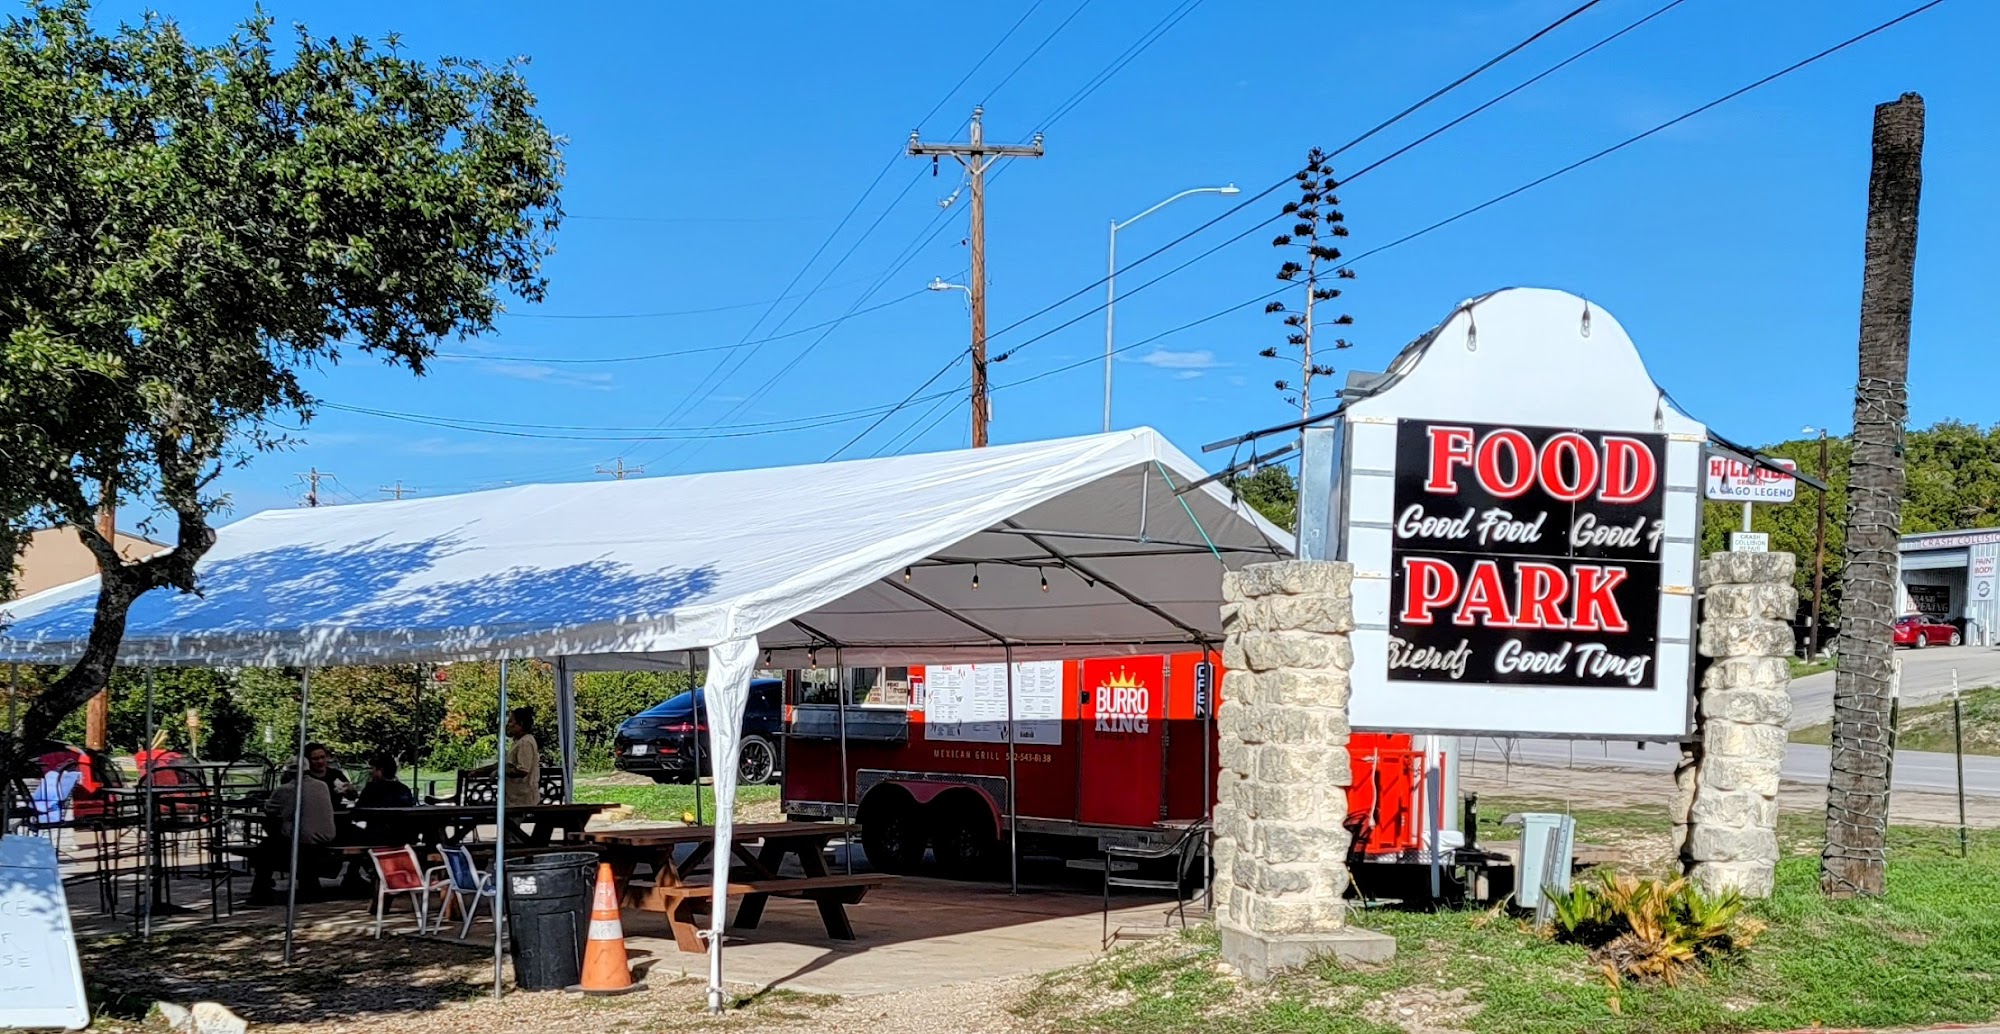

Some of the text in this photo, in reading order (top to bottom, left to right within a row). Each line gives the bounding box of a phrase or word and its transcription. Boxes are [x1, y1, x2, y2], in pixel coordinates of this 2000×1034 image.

[1425, 426, 1658, 505] FOOD
[1709, 486, 1793, 498] A AGO LEGEND
[1397, 504, 1476, 540] Good
[1478, 507, 1548, 546] Food
[1570, 512, 1647, 548] Good
[1922, 538, 1954, 548] CRASH
[1974, 566, 1994, 574] BODY
[1401, 557, 1629, 633] PARK
[1494, 638, 1573, 676] Good
[1575, 643, 1652, 686] Times
[1096, 686, 1149, 714] BURRO
[1095, 712, 1149, 734] KING
[933, 749, 1052, 763] MEXICAN GRILL 52-543-6138
